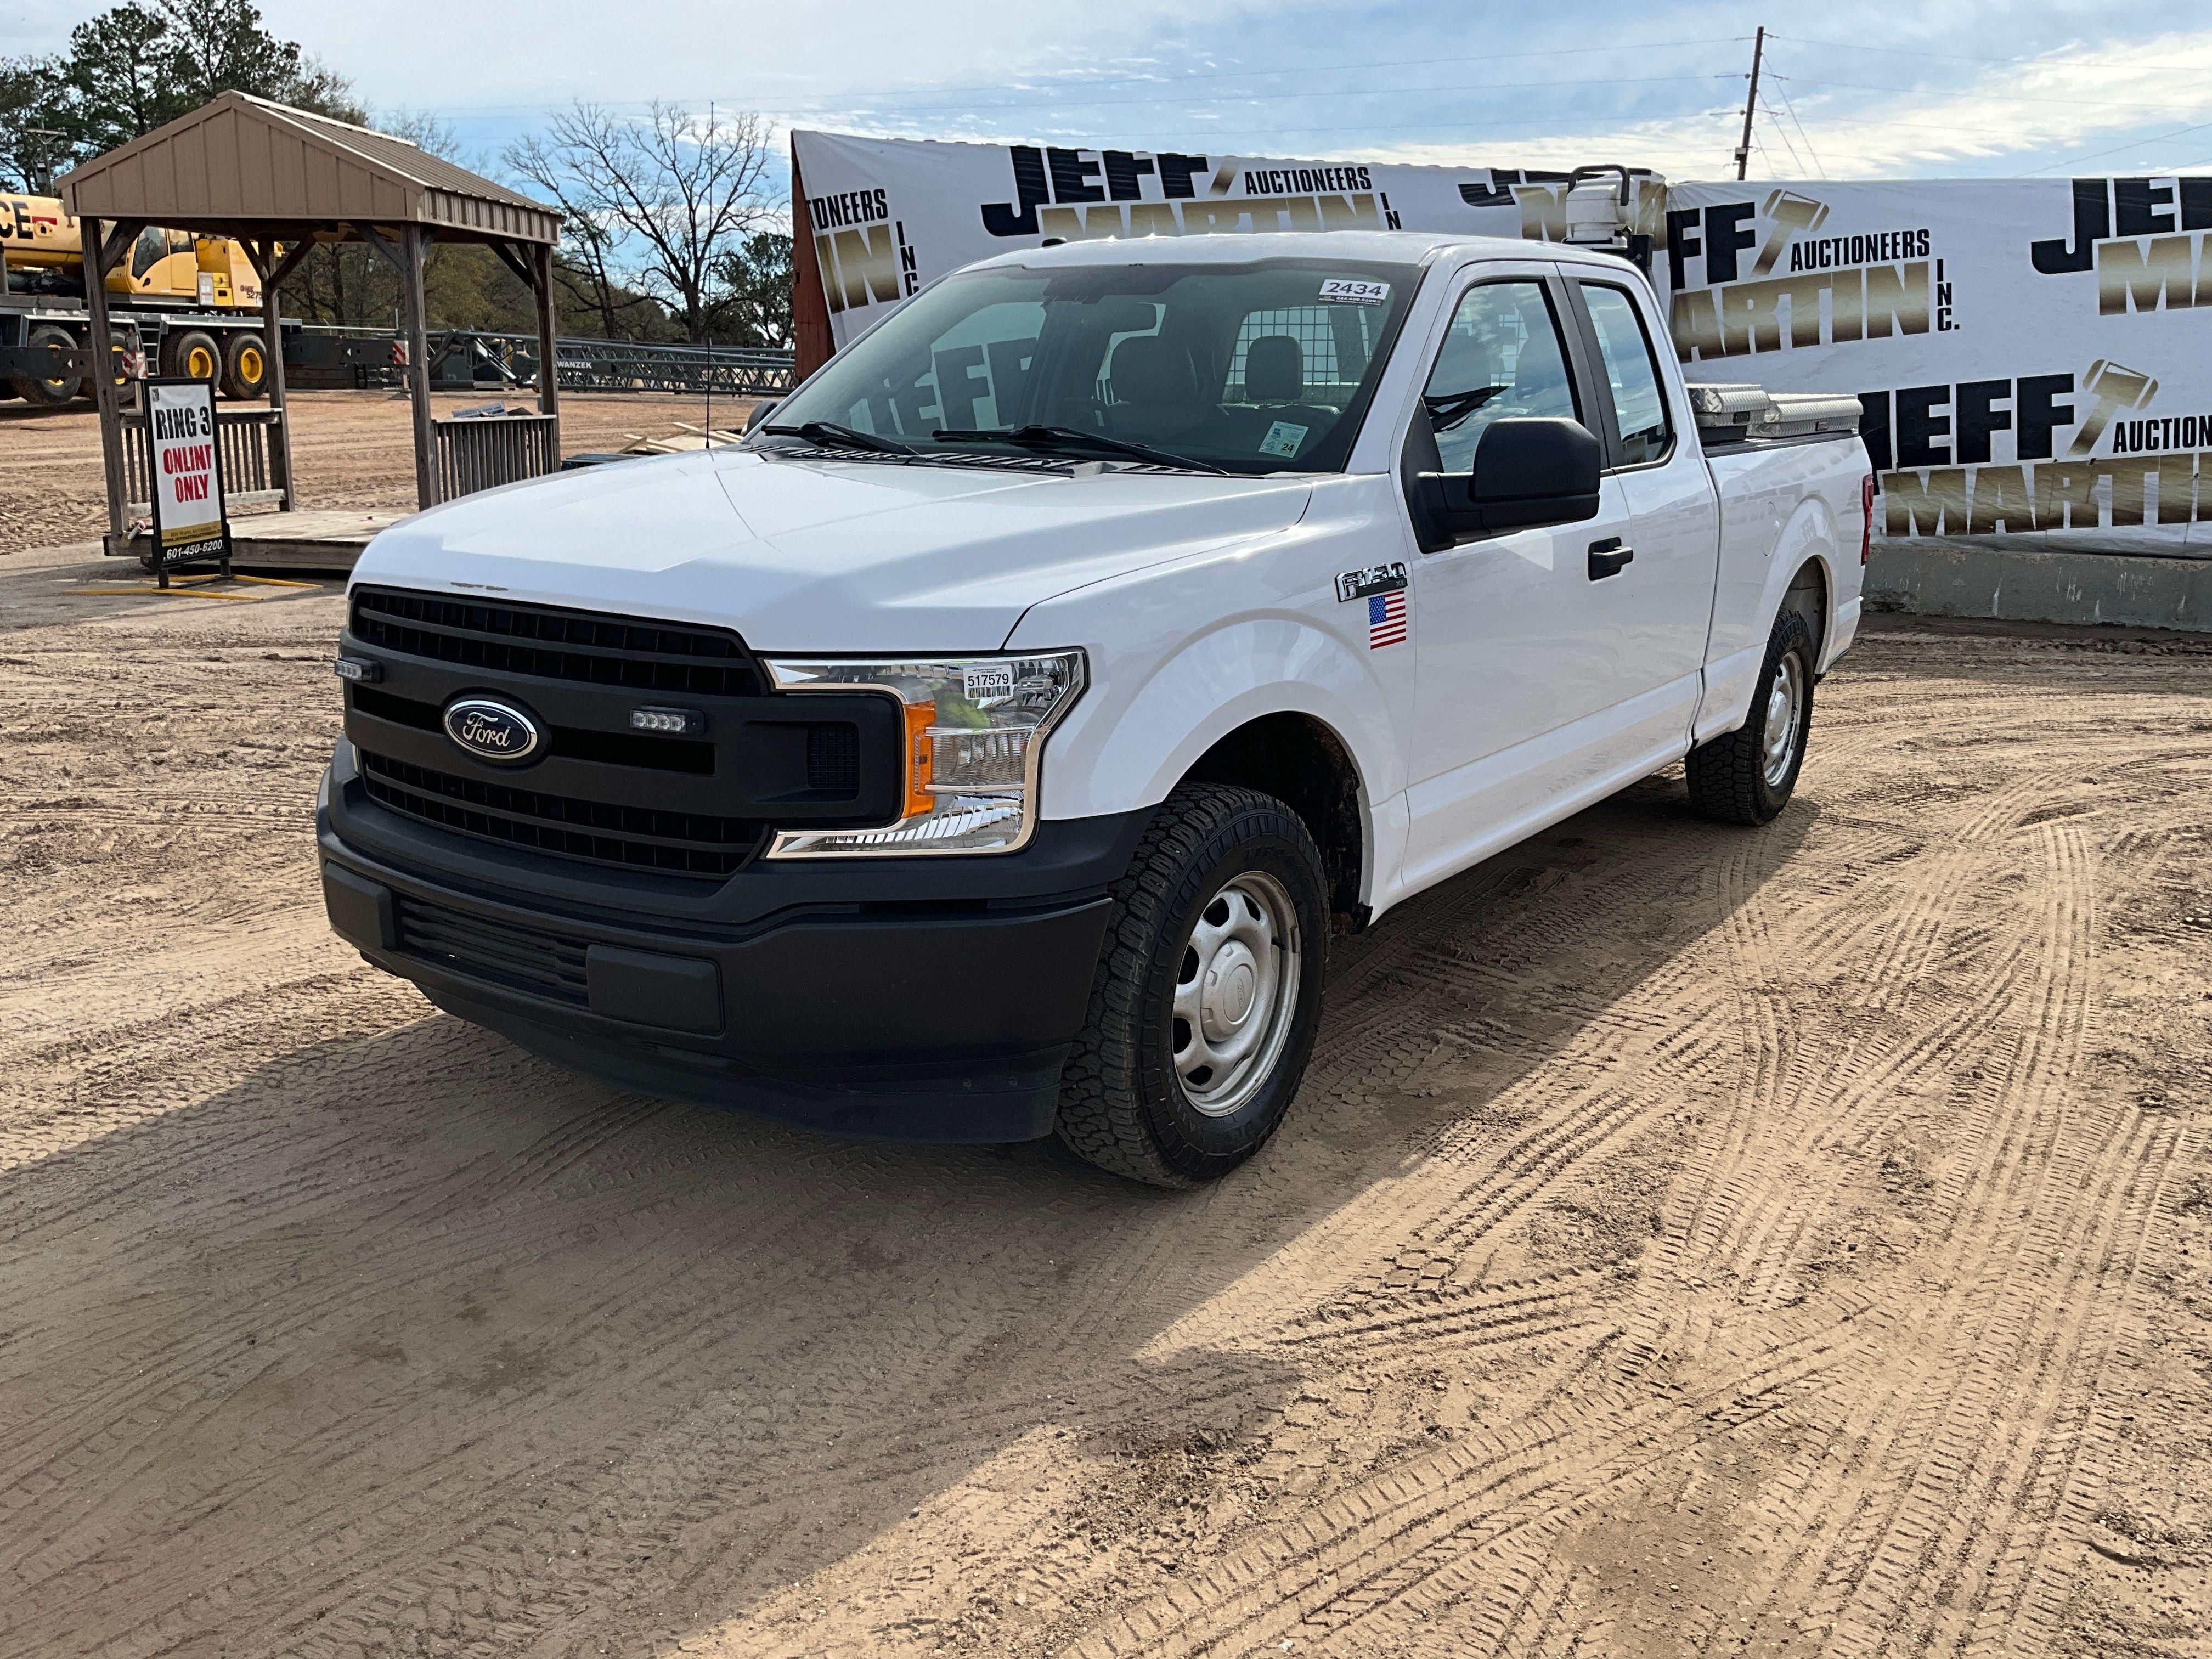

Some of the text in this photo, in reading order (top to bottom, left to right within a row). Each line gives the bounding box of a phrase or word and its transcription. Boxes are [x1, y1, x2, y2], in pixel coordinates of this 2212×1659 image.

[981, 145, 1209, 236] JEFF
[1244, 167, 1372, 195] AUCTIONEERS
[1790, 228, 1930, 272] AUCTIONEERS
[1327, 282, 1381, 296] 2434
[1937, 258, 1960, 331] INC.
[557, 360, 592, 369] WANZEK
[155, 406, 211, 439] RING 3
[1282, 443, 1295, 452] 24
[174, 473, 208, 503] ONLY
[1882, 452, 2212, 537] MARTI
[166, 539, 223, 560] 601-450-6200
[968, 674, 1009, 686] 517579
[462, 712, 511, 747] Ford
